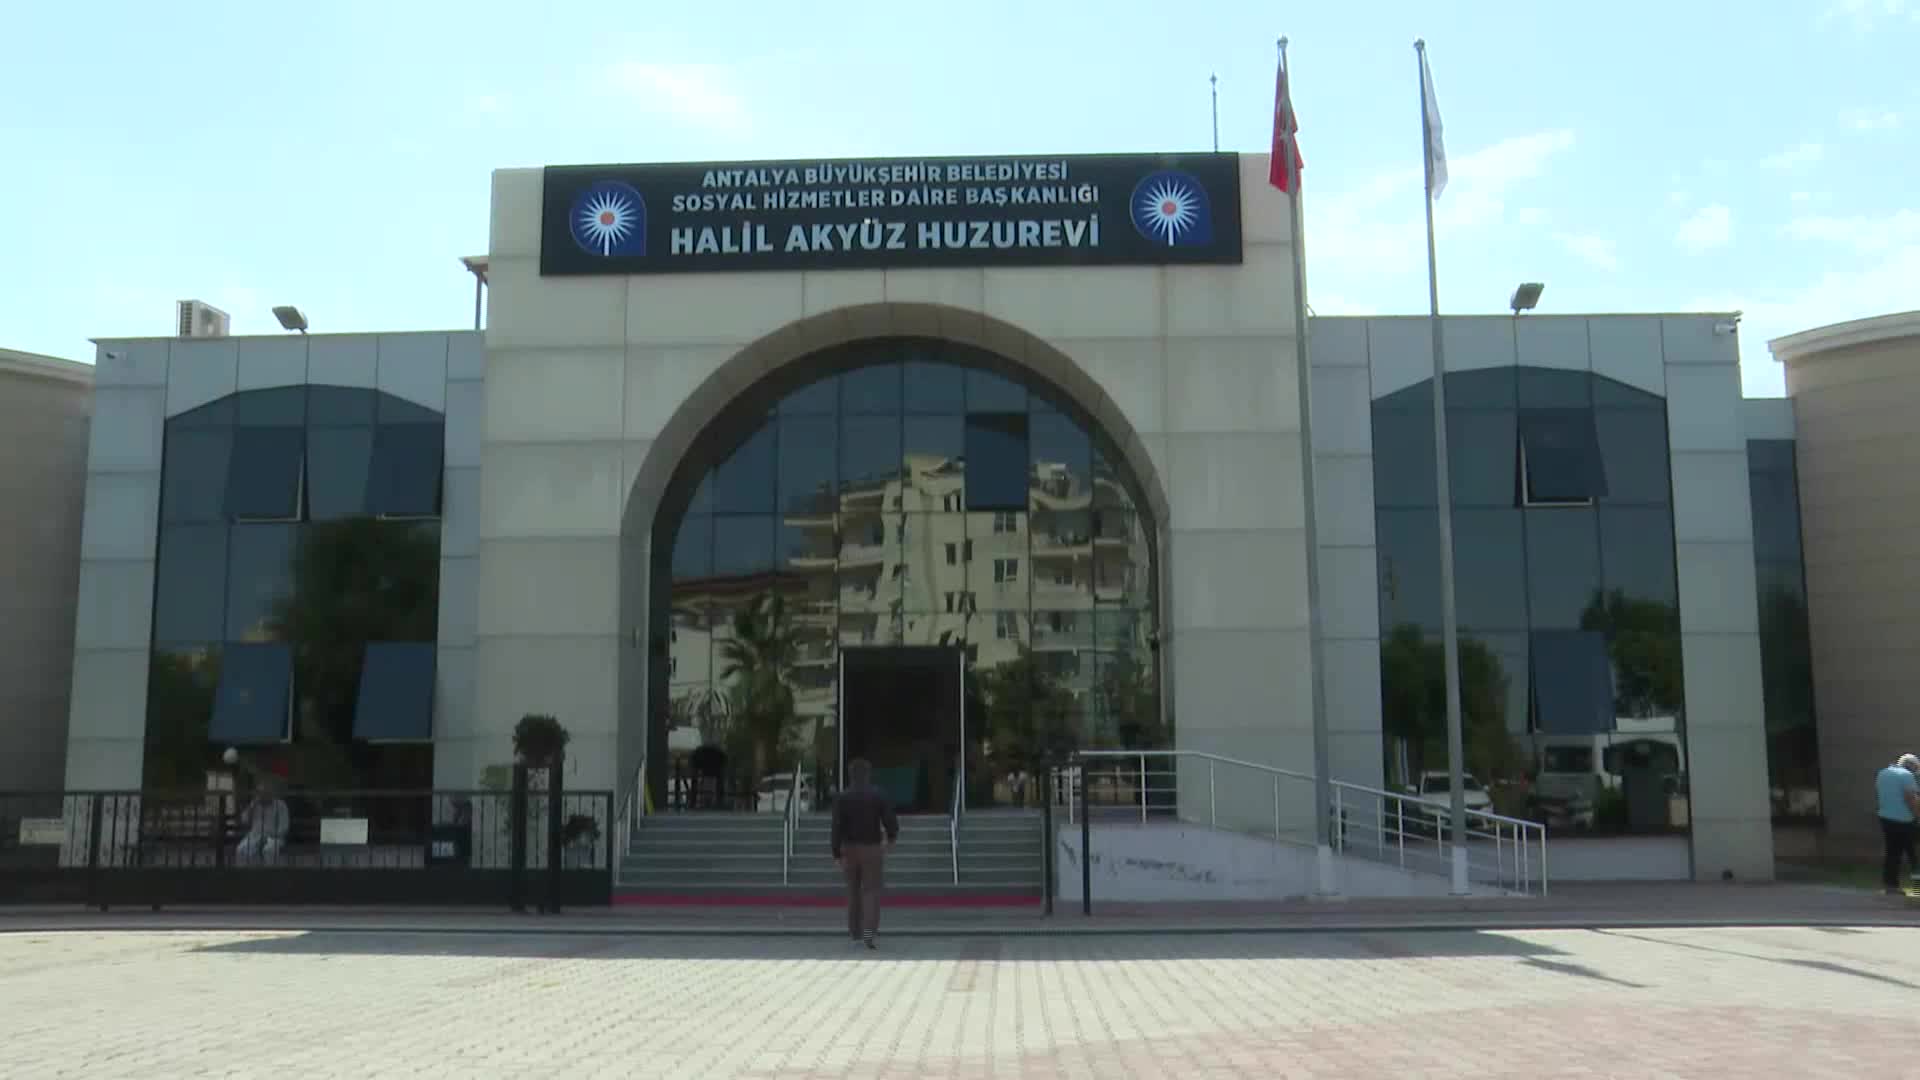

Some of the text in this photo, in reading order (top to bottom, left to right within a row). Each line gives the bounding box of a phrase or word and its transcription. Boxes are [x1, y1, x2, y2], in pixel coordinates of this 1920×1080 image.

[702, 159, 1068, 188] ANTALYA BÜYÜKŞEHİR BELEDİYESİ
[672, 193, 756, 212] SOSYAL
[763, 188, 885, 209] HİZMETLER
[890, 185, 958, 206] DAİRE
[671, 213, 1100, 255] HALİL AKYÜZ HUZUREVİ
